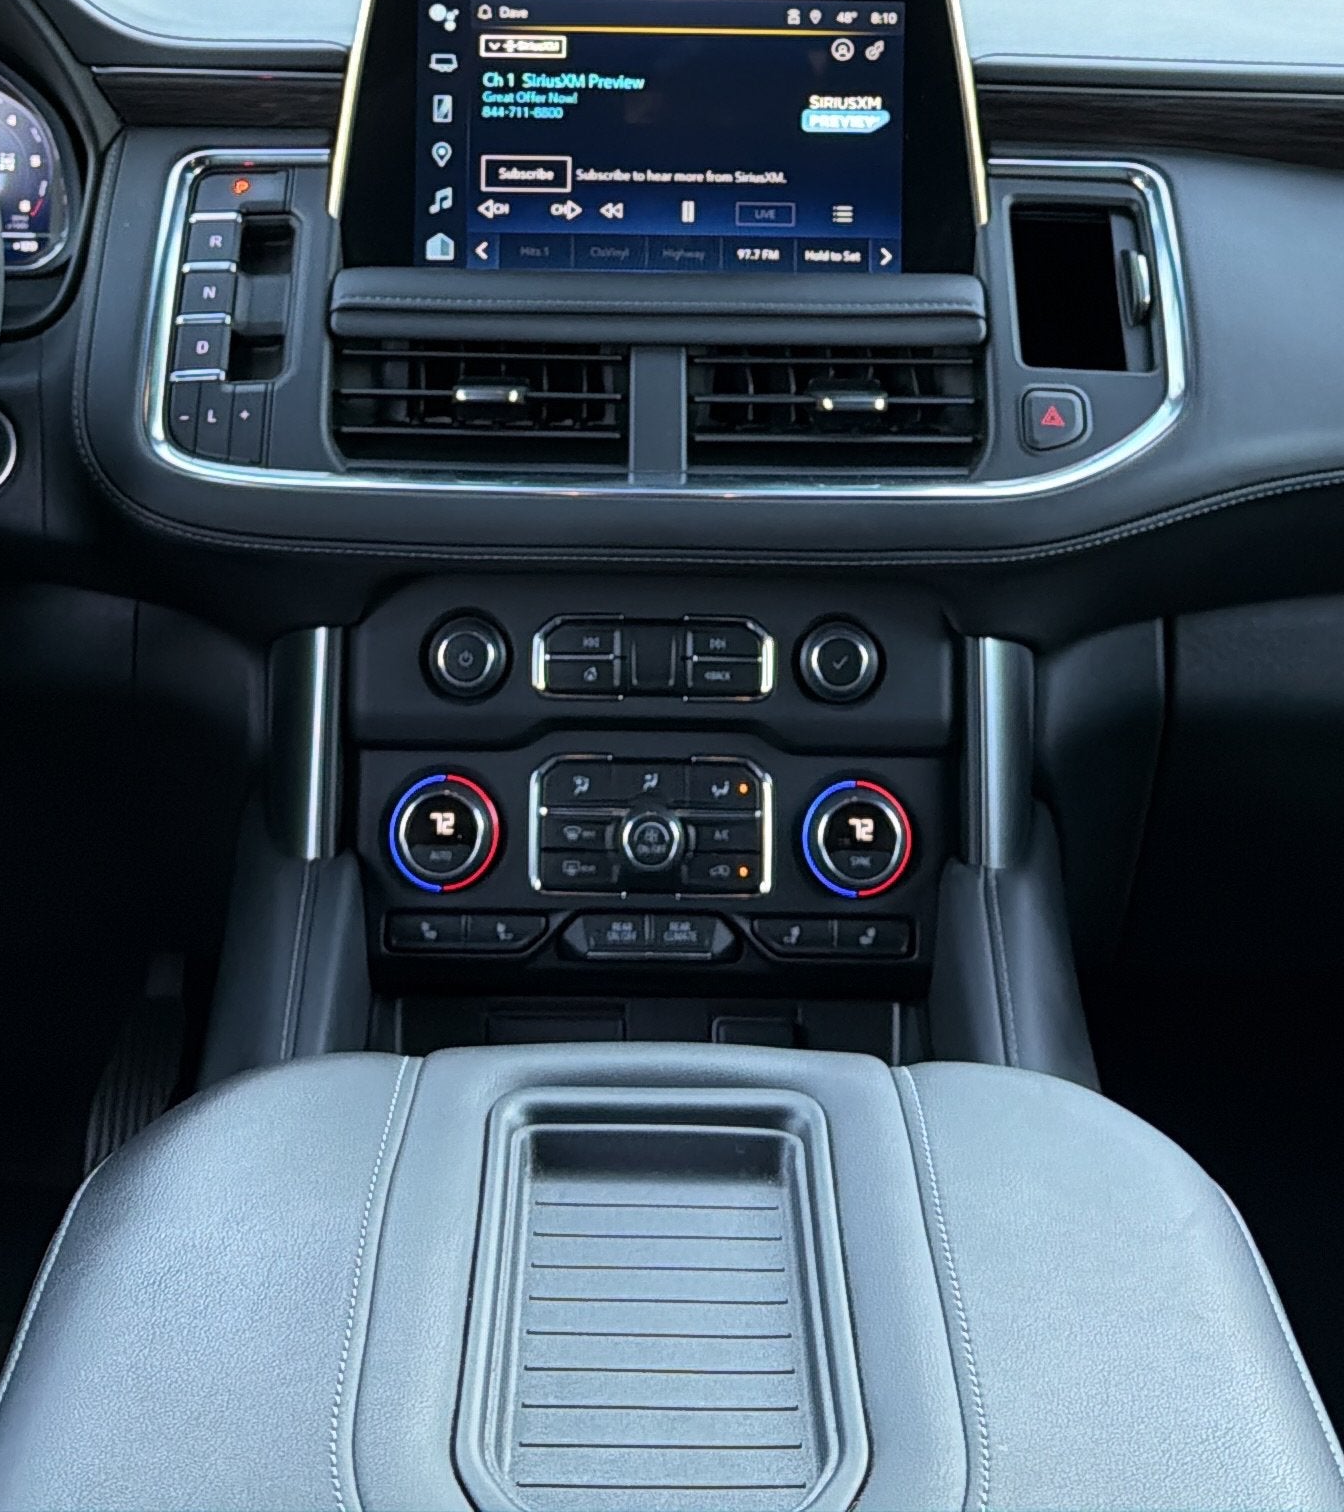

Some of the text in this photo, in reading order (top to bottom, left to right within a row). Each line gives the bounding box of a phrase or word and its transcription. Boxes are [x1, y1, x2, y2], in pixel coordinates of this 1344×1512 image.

[870, 11, 898, 25] 8:10
[482, 72, 645, 90] Ch 1 SiriusXM Preview
[482, 91, 579, 105] Great Offer Now!
[808, 95, 882, 110] SIRIUSXM
[809, 114, 882, 129] PREVIEW
[498, 167, 555, 181] Subscribe
[575, 168, 787, 184] Subscribe to hear more from SiriusXM.
[209, 234, 223, 248] R
[662, 248, 705, 262] Highway
[736, 249, 780, 261] 97.7 FM
[805, 249, 861, 263] Hold to Set
[202, 286, 216, 299] N
[195, 340, 210, 355] D
[207, 409, 217, 424] L
[429, 812, 455, 836] 72
[848, 817, 874, 842] 72
[611, 921, 633, 931] REAR
[669, 921, 691, 931] REAR
